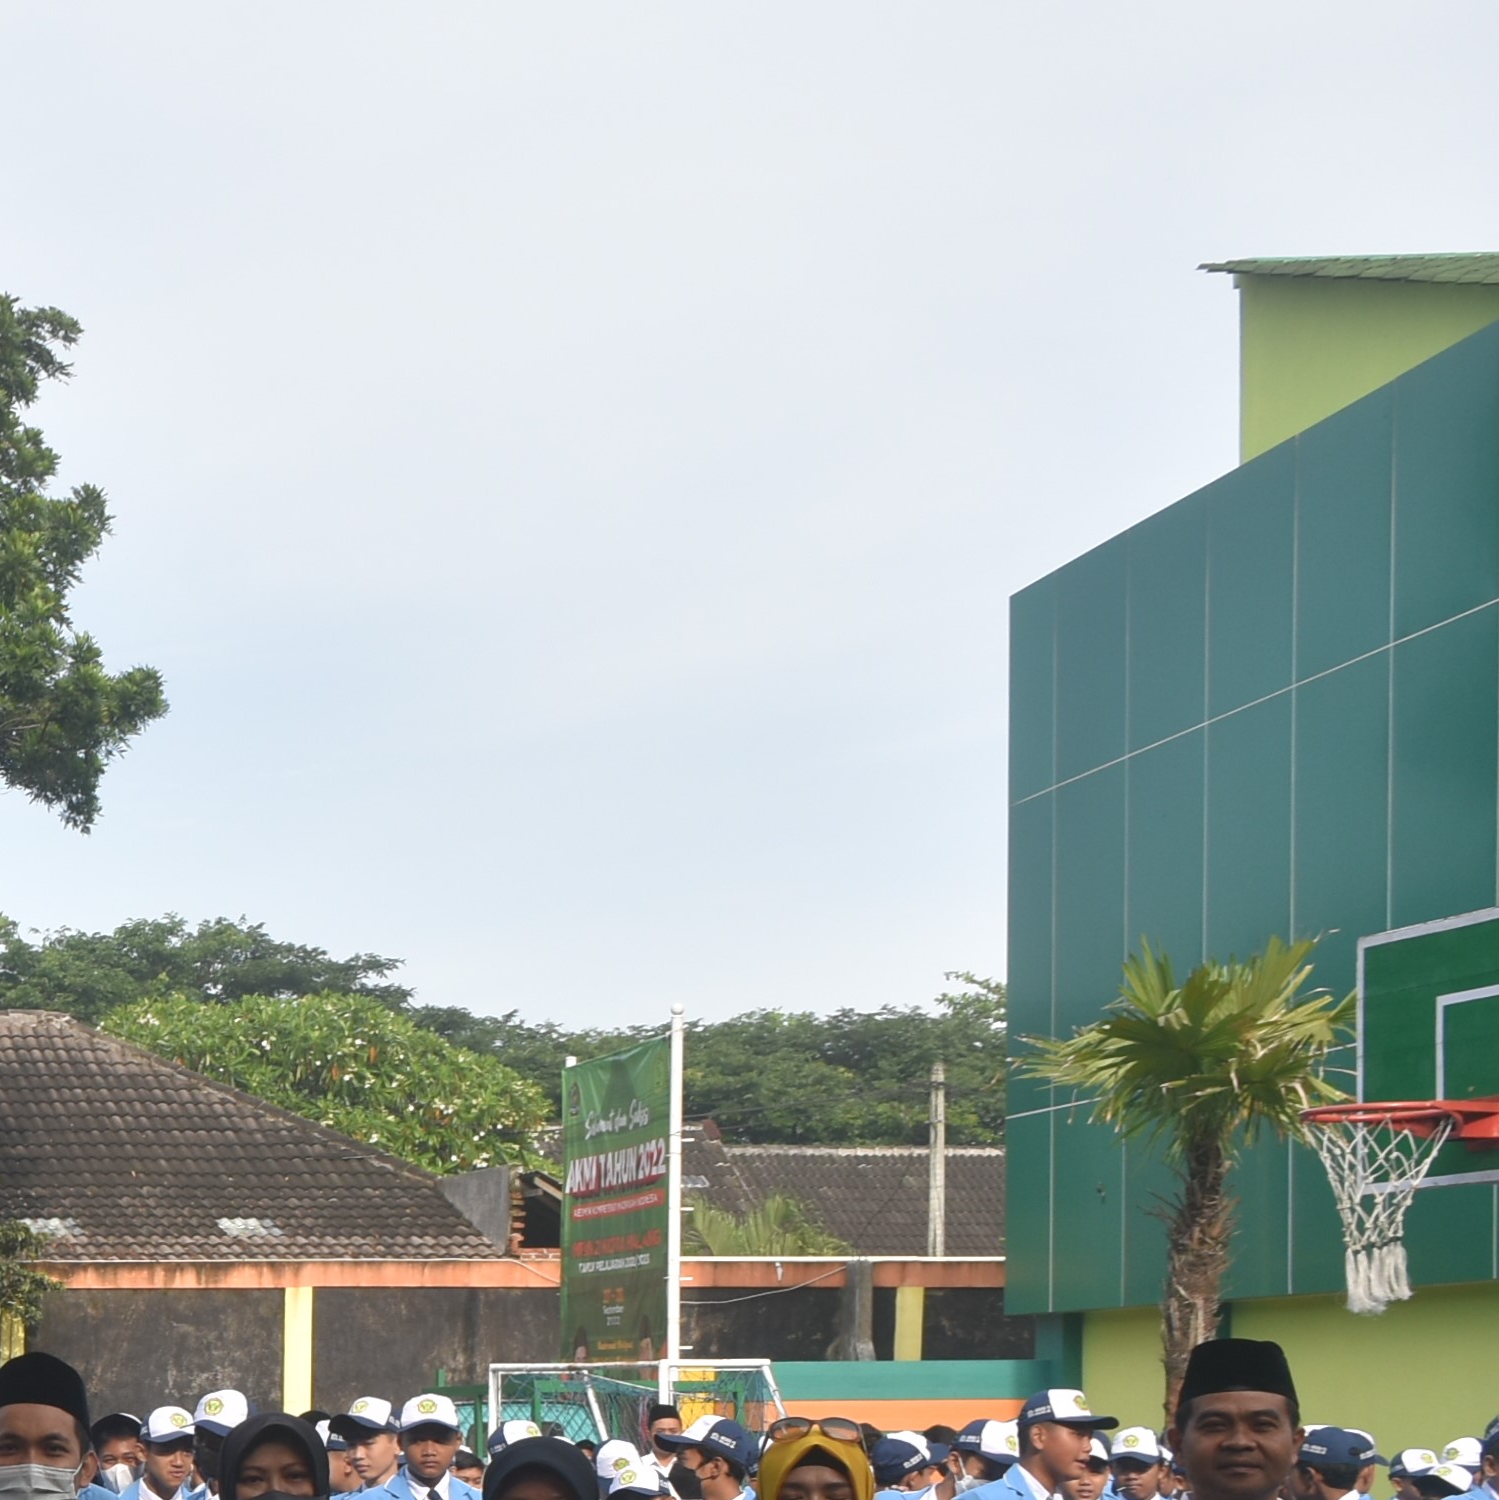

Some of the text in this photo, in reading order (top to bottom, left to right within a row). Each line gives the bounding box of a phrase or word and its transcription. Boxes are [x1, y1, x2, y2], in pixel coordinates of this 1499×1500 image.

[565, 1138, 666, 1194] AKMI TAHUN 2022
